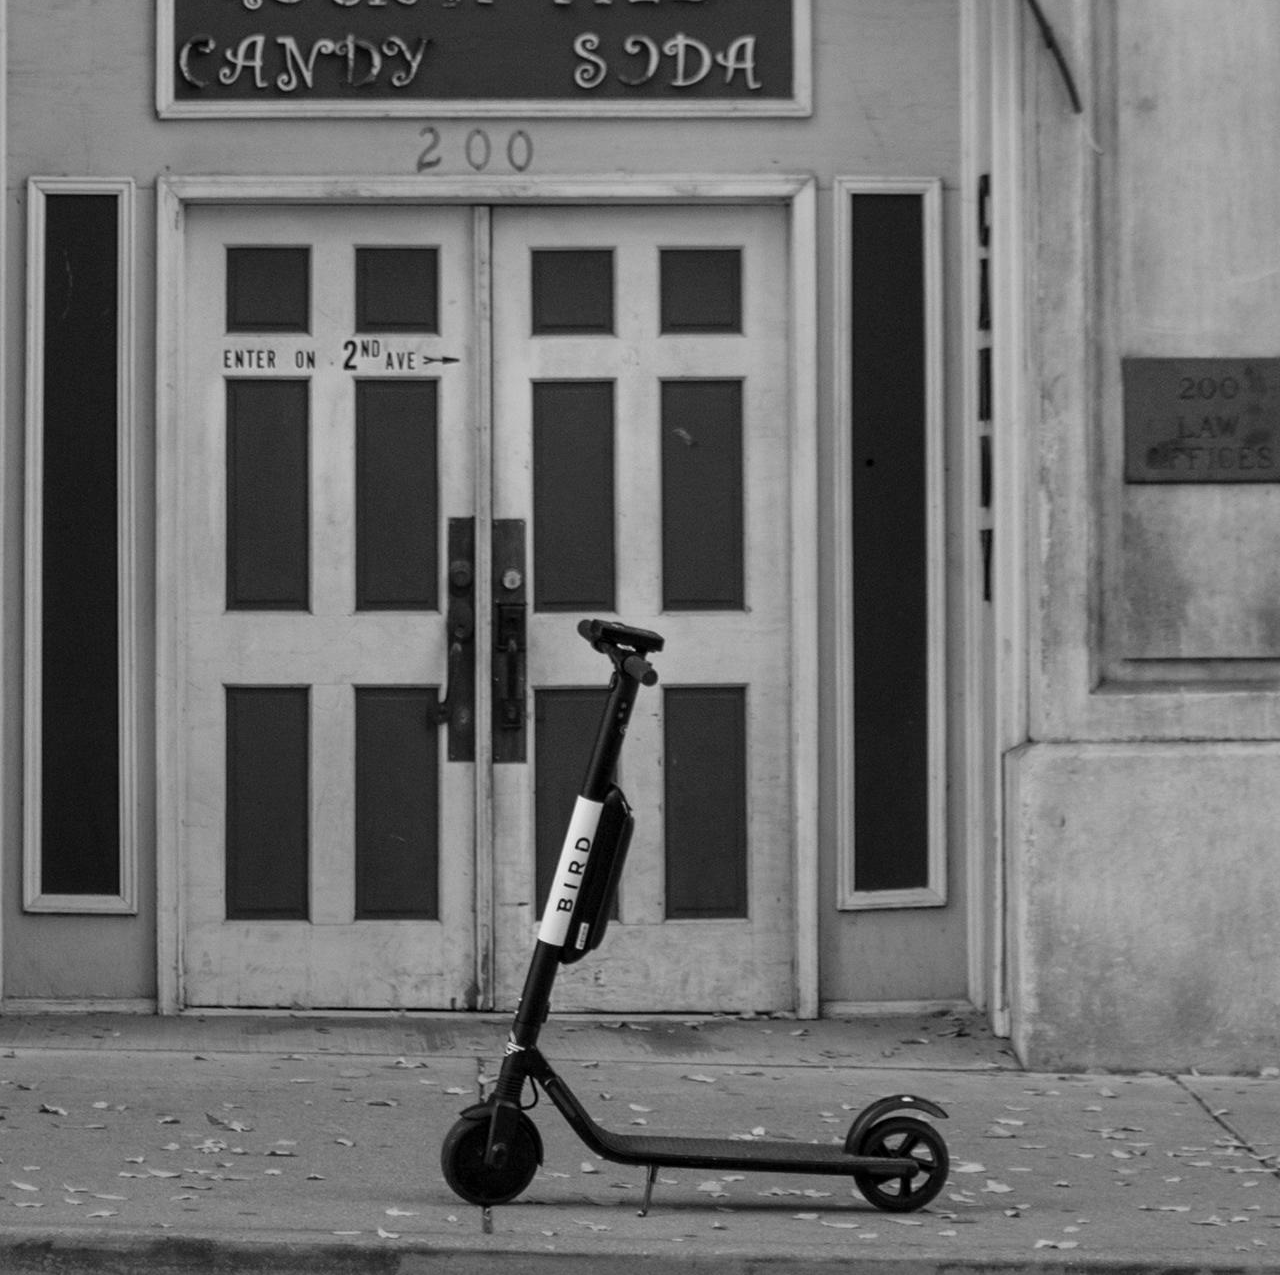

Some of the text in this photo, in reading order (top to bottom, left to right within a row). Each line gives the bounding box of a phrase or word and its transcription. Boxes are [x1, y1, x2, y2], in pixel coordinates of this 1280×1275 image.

[178, 32, 763, 92] CANDY SODA
[416, 126, 535, 172] 200
[223, 338, 417, 371] ENTER ON 2ND AVE
[1179, 377, 1239, 399] 200
[1177, 415, 1240, 439] LAW
[556, 837, 591, 913] BIRD
